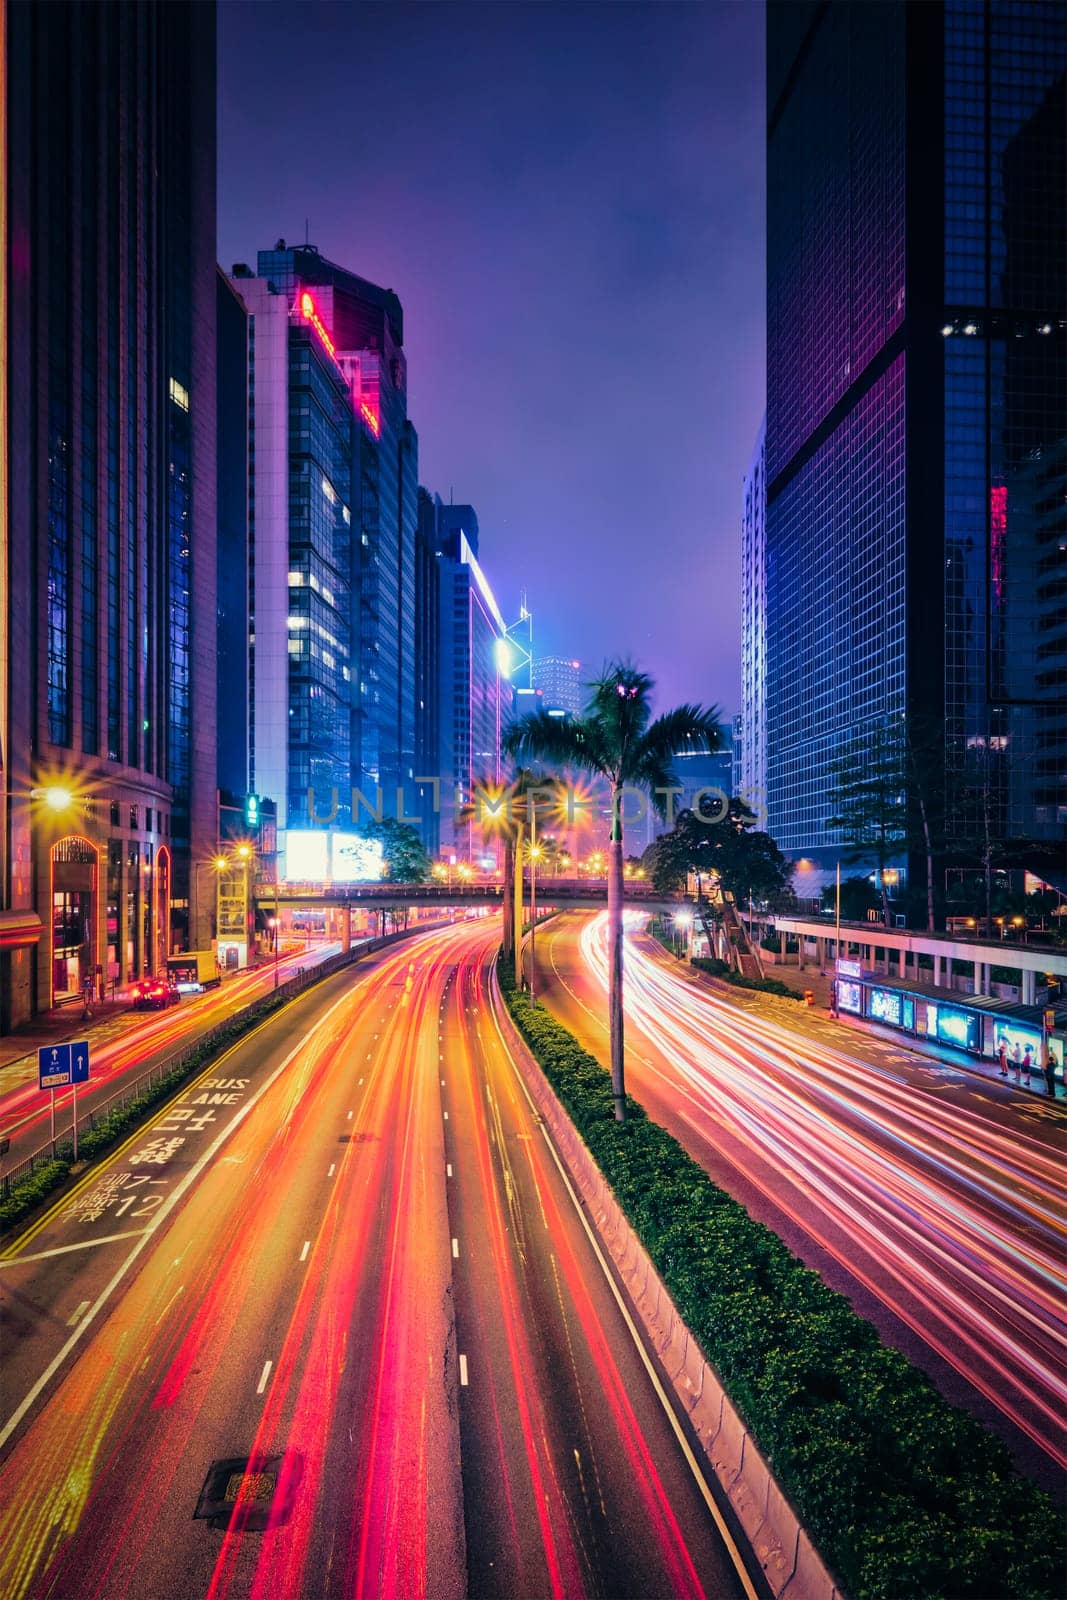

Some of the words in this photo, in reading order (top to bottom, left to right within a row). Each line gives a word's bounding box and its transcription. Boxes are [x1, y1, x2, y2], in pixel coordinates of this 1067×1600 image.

[198, 1079, 250, 1089] BUS
[176, 1093, 243, 1105] LANE
[152, 1109, 216, 1131] 巴士
[115, 1195, 164, 1217] 12
